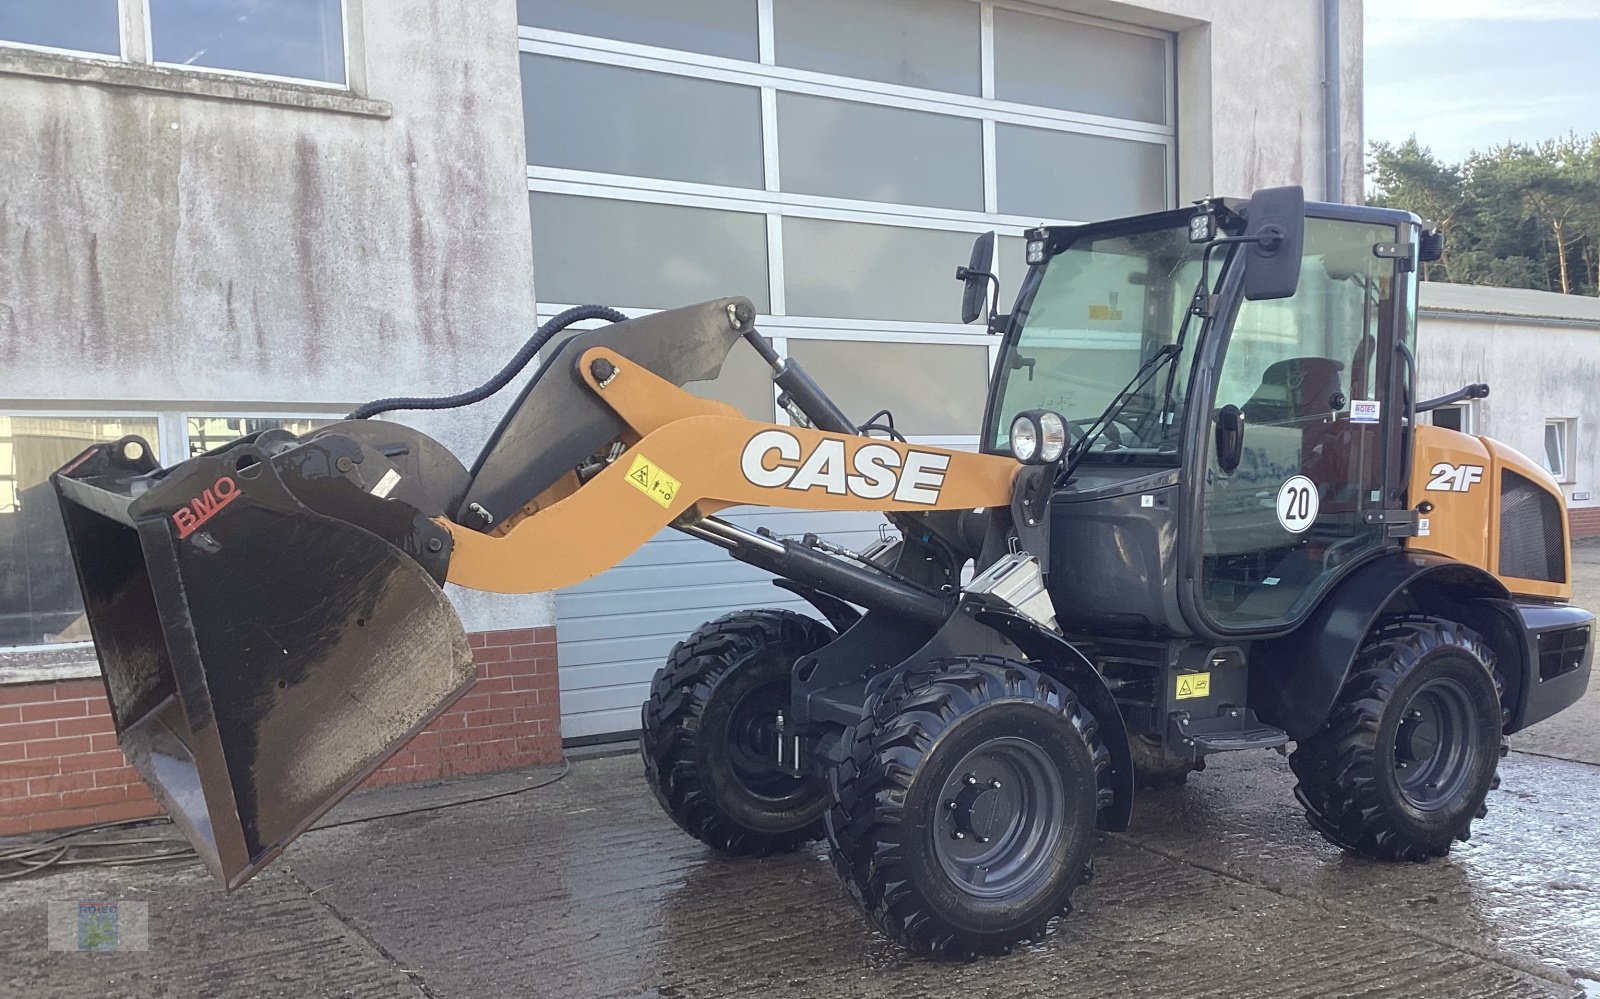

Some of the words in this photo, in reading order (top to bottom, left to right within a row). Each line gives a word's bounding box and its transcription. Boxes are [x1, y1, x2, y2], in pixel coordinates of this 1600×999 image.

[741, 428, 951, 505] CASE
[1424, 462, 1484, 493] 21F
[172, 476, 239, 538] BMO
[1285, 486, 1310, 520] 20
